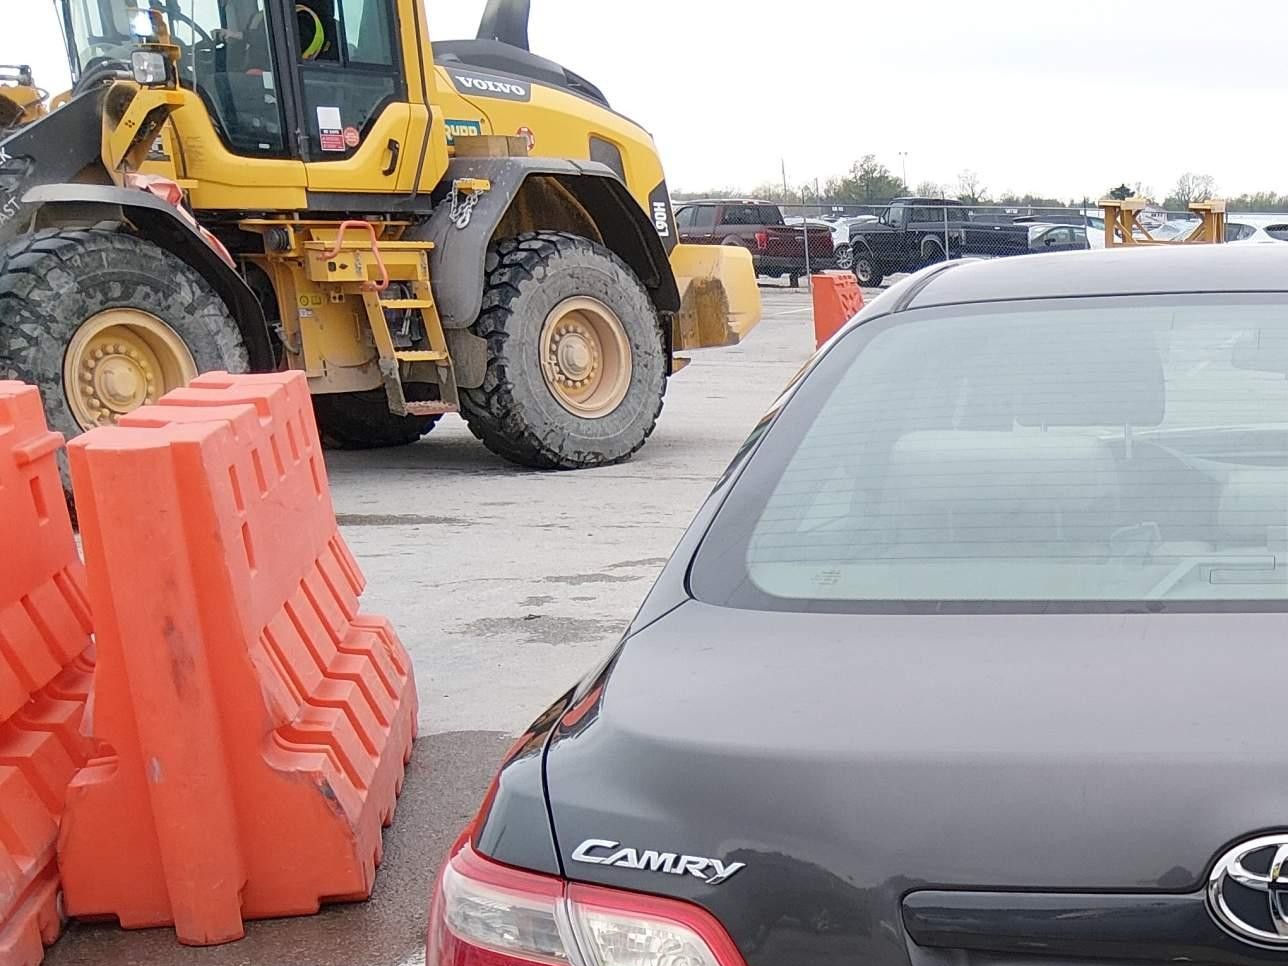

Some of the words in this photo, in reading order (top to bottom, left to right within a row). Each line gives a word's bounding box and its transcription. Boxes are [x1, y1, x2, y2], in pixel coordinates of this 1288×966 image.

[454, 75, 526, 96] VOLVO
[653, 201, 669, 237] L90H
[571, 838, 747, 885] CAMRY
